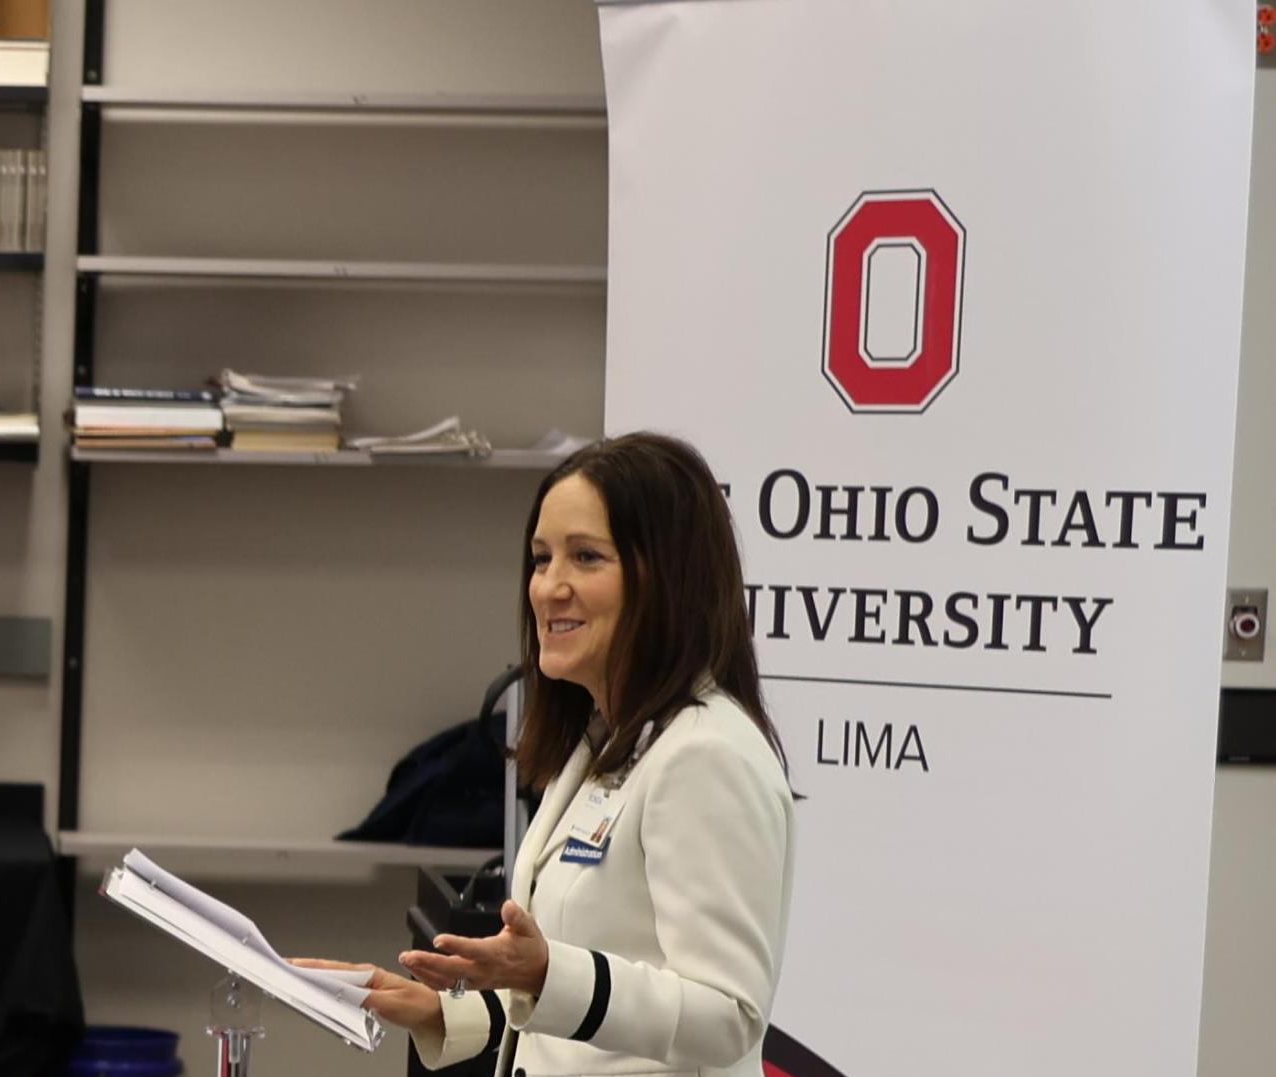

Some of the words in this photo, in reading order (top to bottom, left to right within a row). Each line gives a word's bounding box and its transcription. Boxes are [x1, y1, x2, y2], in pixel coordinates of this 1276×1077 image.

[758, 468, 940, 544] OHIO
[966, 471, 1207, 551] STATE
[744, 584, 1114, 655] IVERSITY
[817, 718, 929, 772] LIMA
